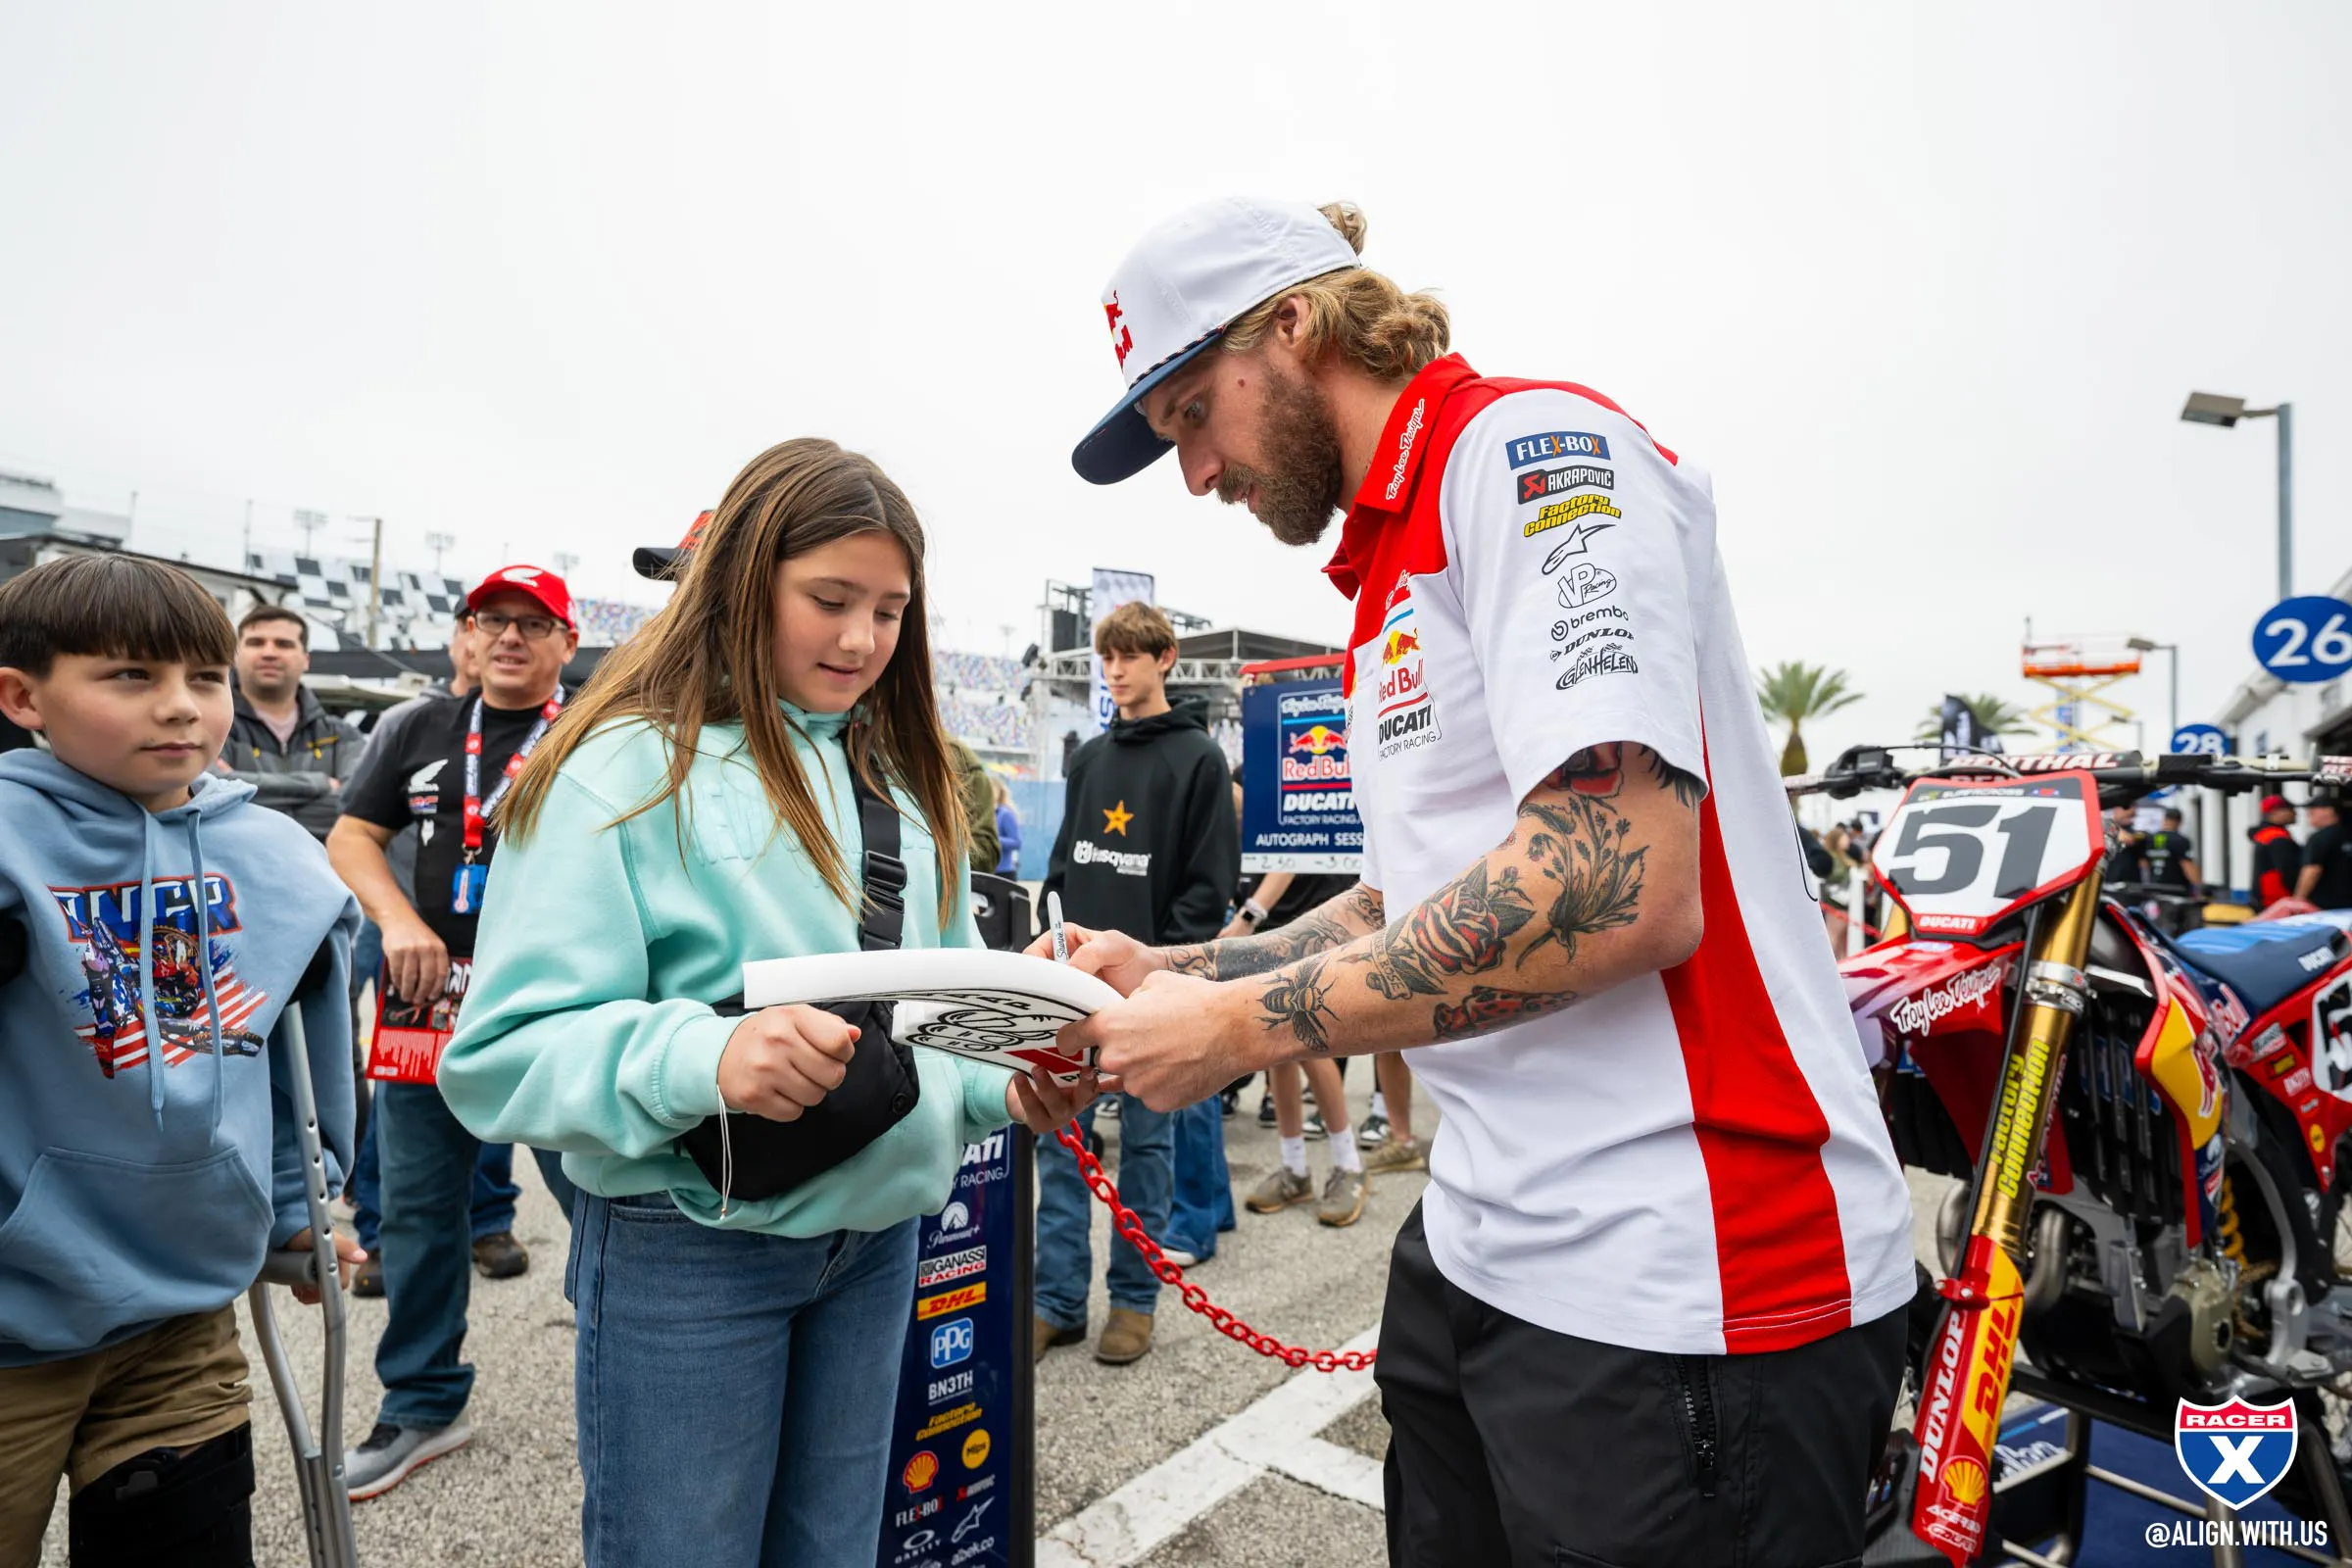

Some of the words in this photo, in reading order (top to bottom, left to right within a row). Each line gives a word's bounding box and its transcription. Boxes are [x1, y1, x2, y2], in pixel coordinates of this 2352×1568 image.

[1516, 435, 1601, 461] FLEX-BOX
[1548, 467, 1612, 491] AKRAPOVIČ
[1539, 494, 1610, 519] Factory
[1557, 563, 1595, 609] VP
[1570, 606, 1629, 628] brembo
[2264, 612, 2352, 666] 26
[1397, 659, 1423, 694] Bull
[1379, 705, 1431, 745] DUCATI
[1403, 731, 1437, 751] RACING
[2176, 732, 2225, 755] 28
[1283, 756, 1318, 781] Red
[1319, 754, 1350, 780] Bul
[1283, 792, 1357, 811] DUCATI
[1255, 832, 1330, 847] AUTOGRAPH
[1334, 831, 1363, 847] SESS
[1887, 805, 2058, 899] 51
[1919, 914, 1977, 930] DUCATI
[1889, 996, 1931, 1037] Troy
[961, 1134, 1004, 1166] ATI
[960, 1166, 1004, 1188] RACING
[919, 1260, 986, 1286] RACING
[933, 1248, 986, 1274] GANASSI
[929, 1288, 975, 1314] DHL
[934, 1326, 971, 1361] PPG
[1975, 1305, 2016, 1421] DHL
[928, 1369, 973, 1401] BN3TH
[1920, 1309, 1967, 1484] DUNLOP
